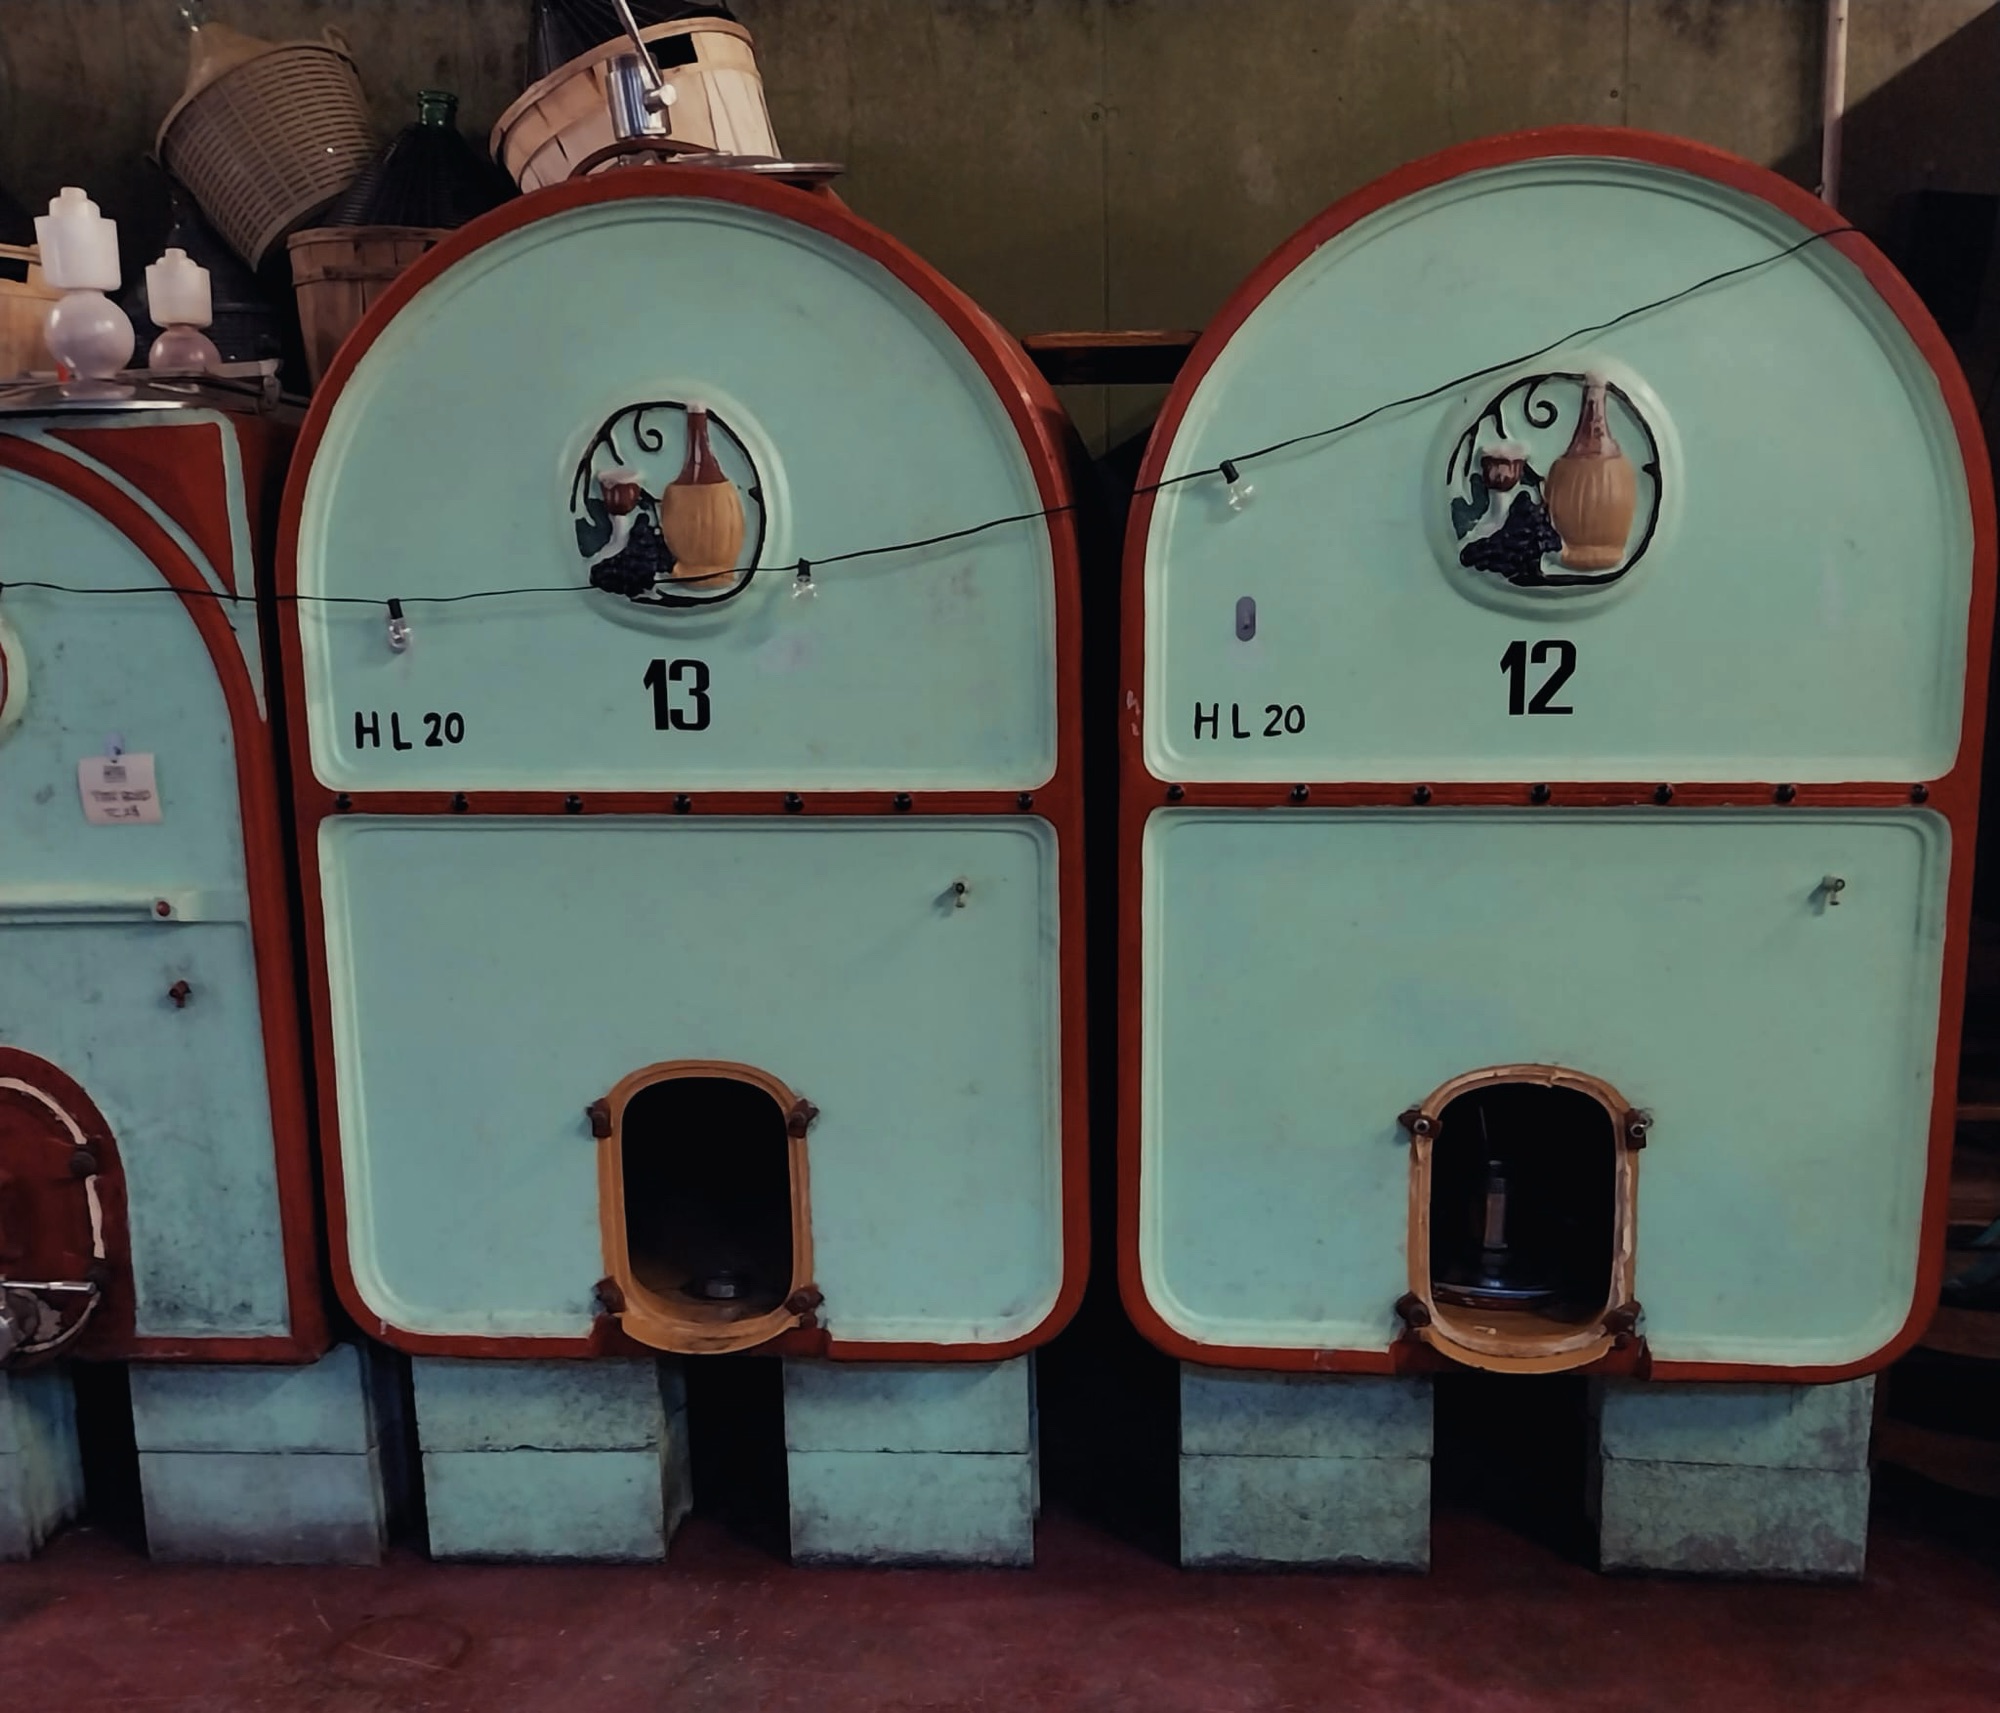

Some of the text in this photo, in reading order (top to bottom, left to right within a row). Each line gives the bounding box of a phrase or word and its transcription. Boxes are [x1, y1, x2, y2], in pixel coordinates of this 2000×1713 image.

[642, 658, 711, 732] 13
[1499, 639, 1577, 716] 12
[422, 711, 465, 748] 20
[1262, 704, 1306, 738] 20
